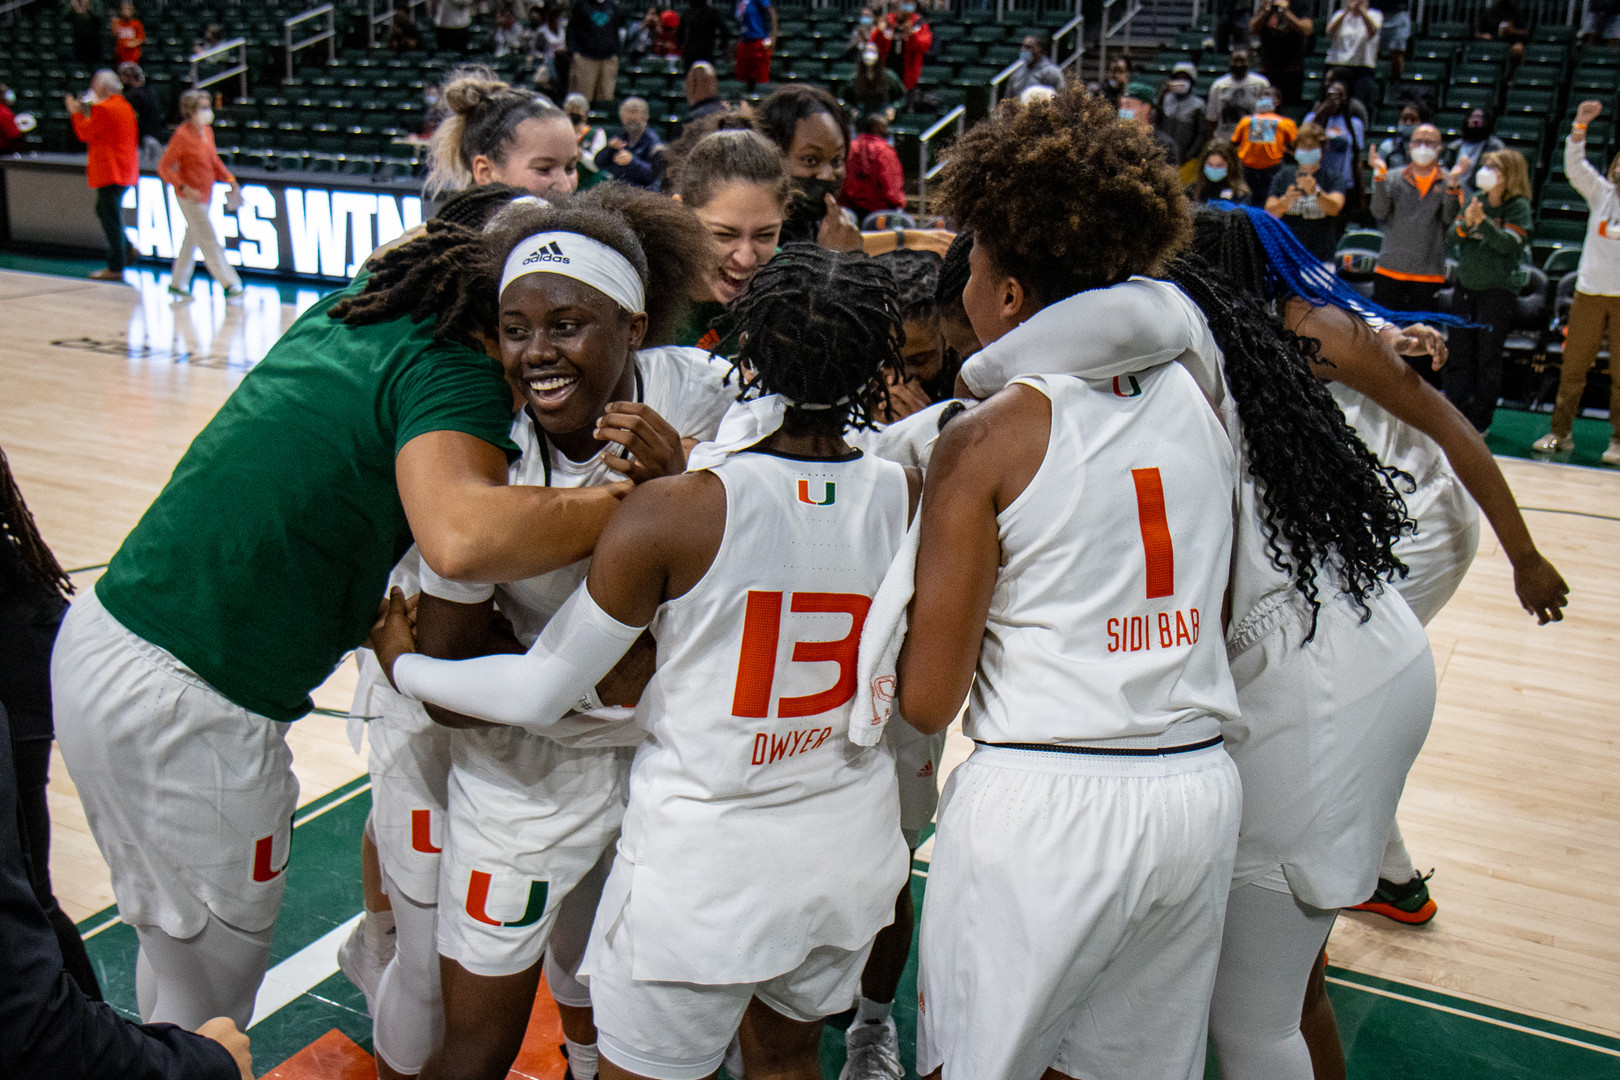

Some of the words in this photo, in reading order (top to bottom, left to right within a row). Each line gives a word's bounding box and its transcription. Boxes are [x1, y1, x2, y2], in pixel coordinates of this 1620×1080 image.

[522, 253, 570, 266] adidas
[798, 479, 836, 506] U
[1131, 467, 1174, 599] 1
[1107, 615, 1150, 652] SIDI
[1158, 608, 1200, 648] BAB
[731, 590, 873, 718] 13
[751, 726, 832, 766] DWYER
[465, 869, 549, 927] U
